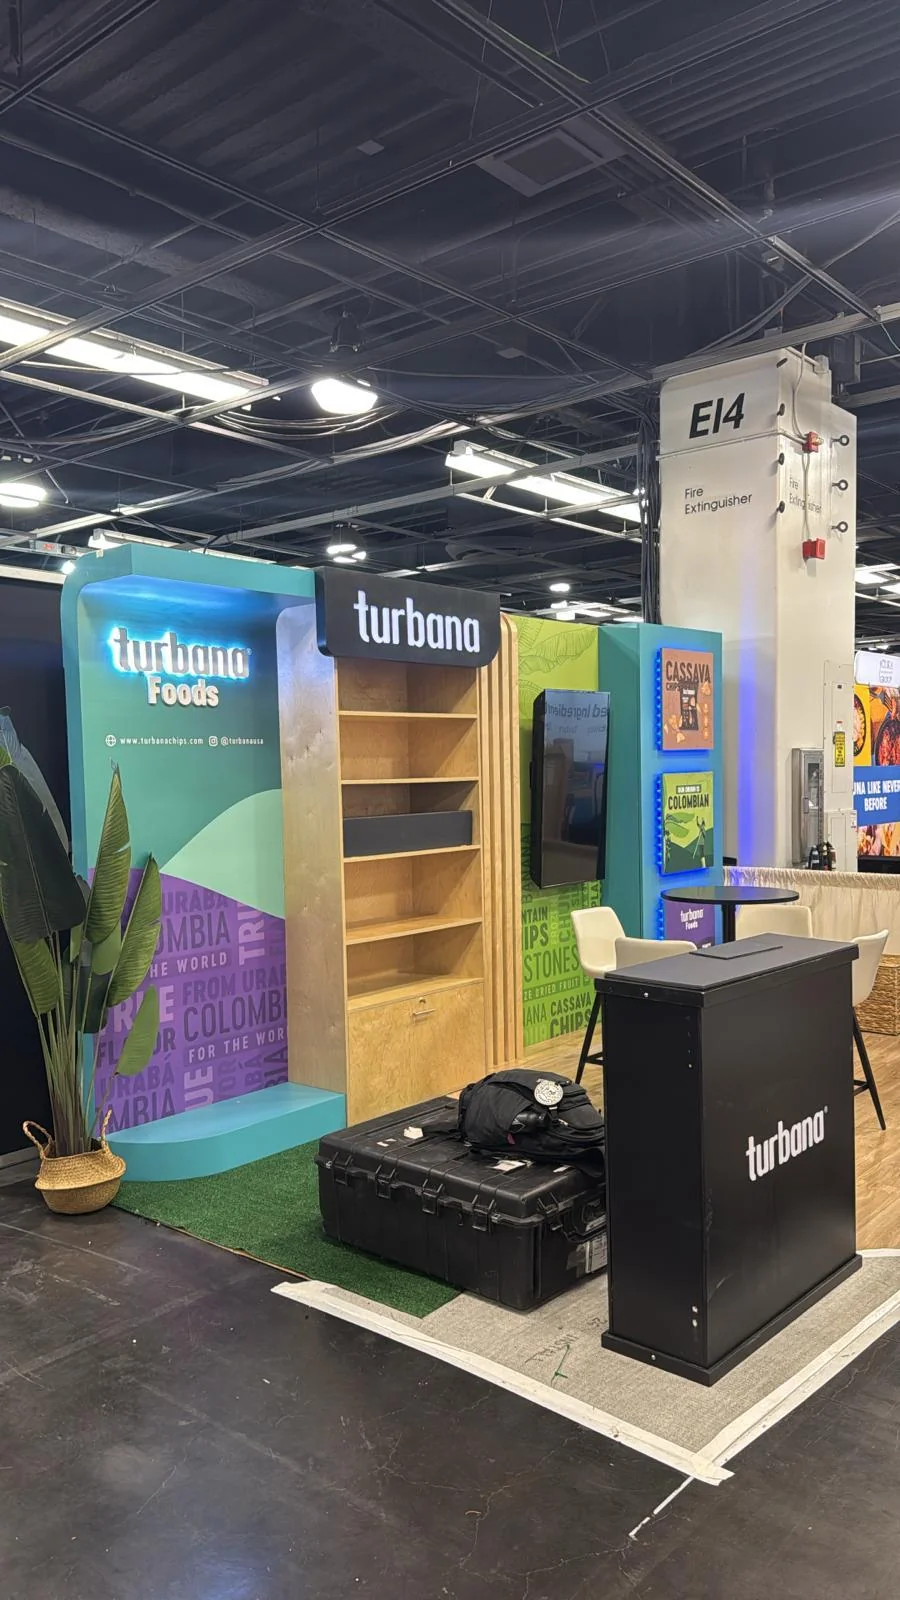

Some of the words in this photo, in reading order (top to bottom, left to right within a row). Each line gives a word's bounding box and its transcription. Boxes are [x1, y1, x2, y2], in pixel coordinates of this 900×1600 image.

[684, 487, 704, 499] Fire
[684, 493, 753, 515] Extinguisher
[353, 590, 480, 653] turbana
[112, 627, 250, 679] turbana
[665, 660, 711, 683] CASSAVA
[147, 676, 219, 707] Foods
[867, 780, 881, 795] LIKE
[667, 793, 710, 811] COLOMBIAN
[864, 796, 888, 812] BEFORE
[177, 952, 227, 973] WORLD
[524, 944, 580, 984] STONES
[550, 991, 592, 1018] CASSAVA
[188, 1043, 216, 1064] FOR
[224, 1035, 249, 1054] THE
[745, 1108, 826, 1182] turbana
